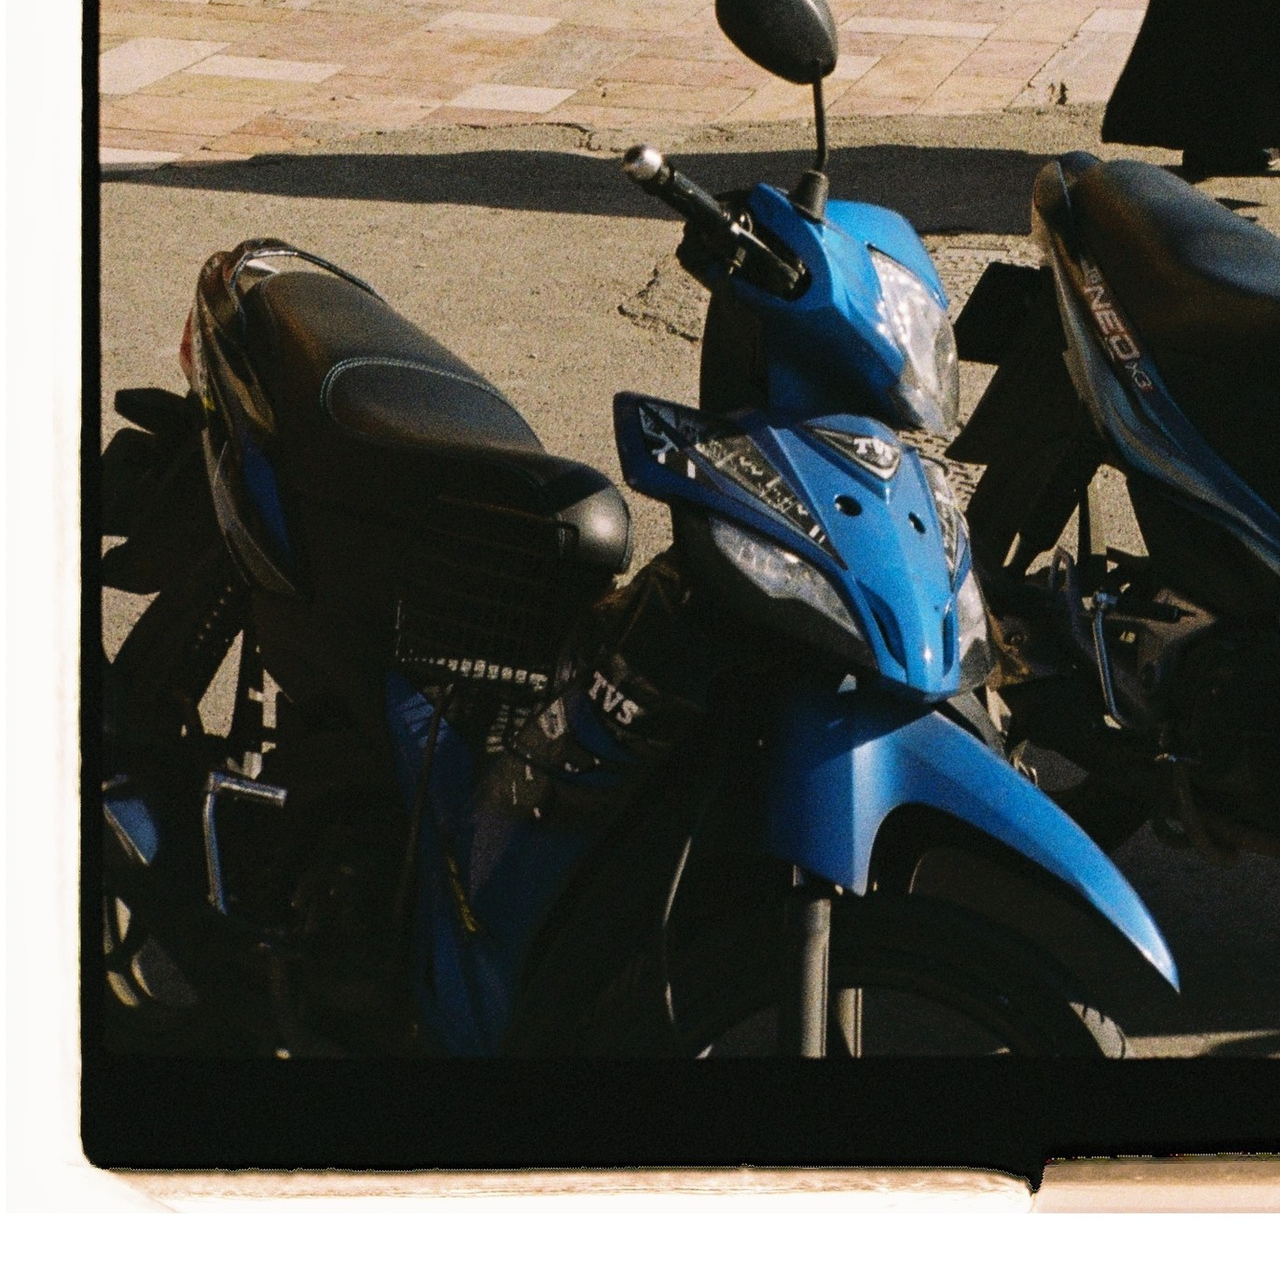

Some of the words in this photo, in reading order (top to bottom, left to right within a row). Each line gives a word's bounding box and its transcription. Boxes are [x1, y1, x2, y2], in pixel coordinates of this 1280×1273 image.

[1084, 285, 1141, 360] NEO
[853, 436, 896, 467] TVS
[588, 670, 640, 726] TVS
